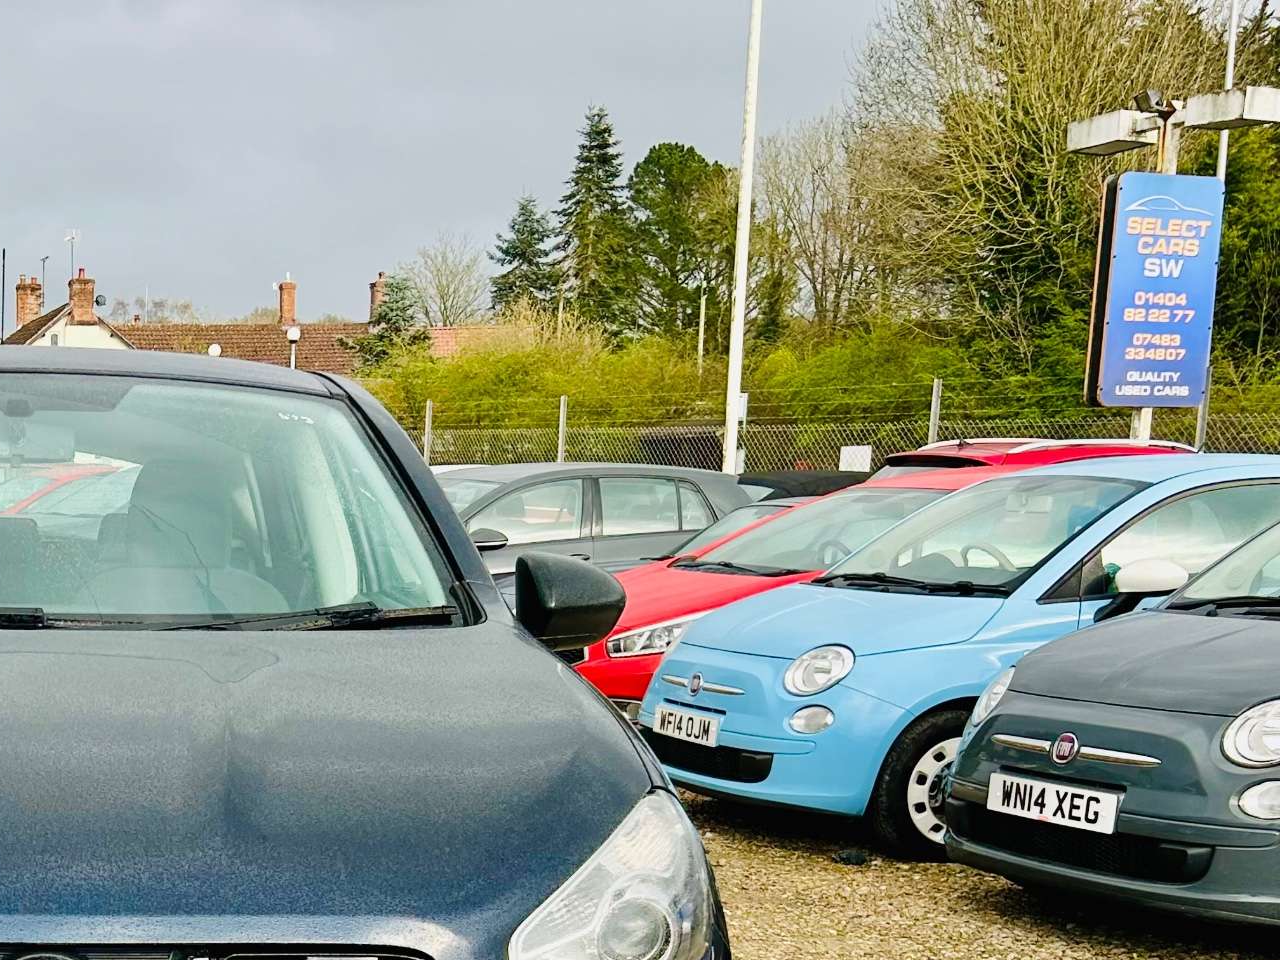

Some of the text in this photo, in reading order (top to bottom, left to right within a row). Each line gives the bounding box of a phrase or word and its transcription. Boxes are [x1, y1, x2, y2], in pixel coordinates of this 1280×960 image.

[1126, 216, 1212, 238] SELECT
[1137, 236, 1200, 257] CARS
[1143, 257, 1184, 279] SW
[1134, 291, 1187, 306] 01404
[1123, 308, 1146, 322] 82
[1172, 310, 1196, 323] 77
[1126, 371, 1181, 382] QUALITY
[1115, 385, 1190, 397] USED CARS
[660, 711, 711, 742] WF14 OJM
[1001, 780, 1101, 825] WN14 XEG
